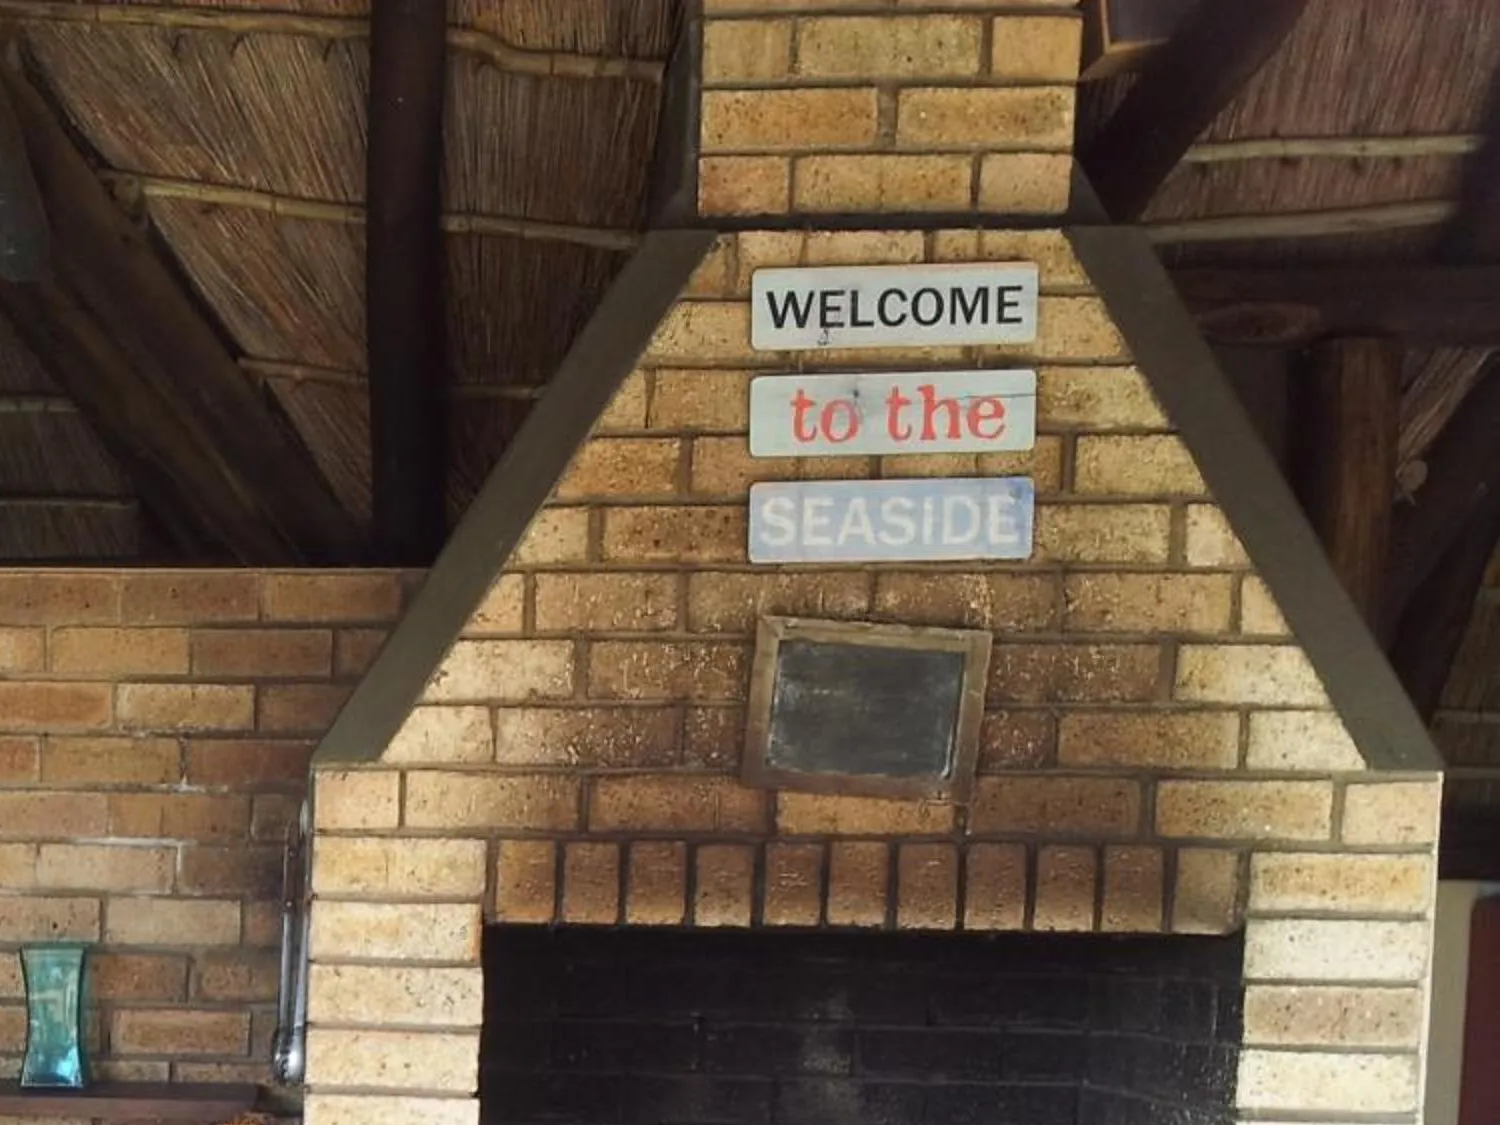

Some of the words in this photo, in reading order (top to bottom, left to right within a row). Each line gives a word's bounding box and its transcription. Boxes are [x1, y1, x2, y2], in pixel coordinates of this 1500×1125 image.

[766, 285, 1023, 329] WELCOME
[790, 388, 859, 443] to
[885, 384, 1006, 443] the
[760, 495, 1017, 545] SEASIDE
